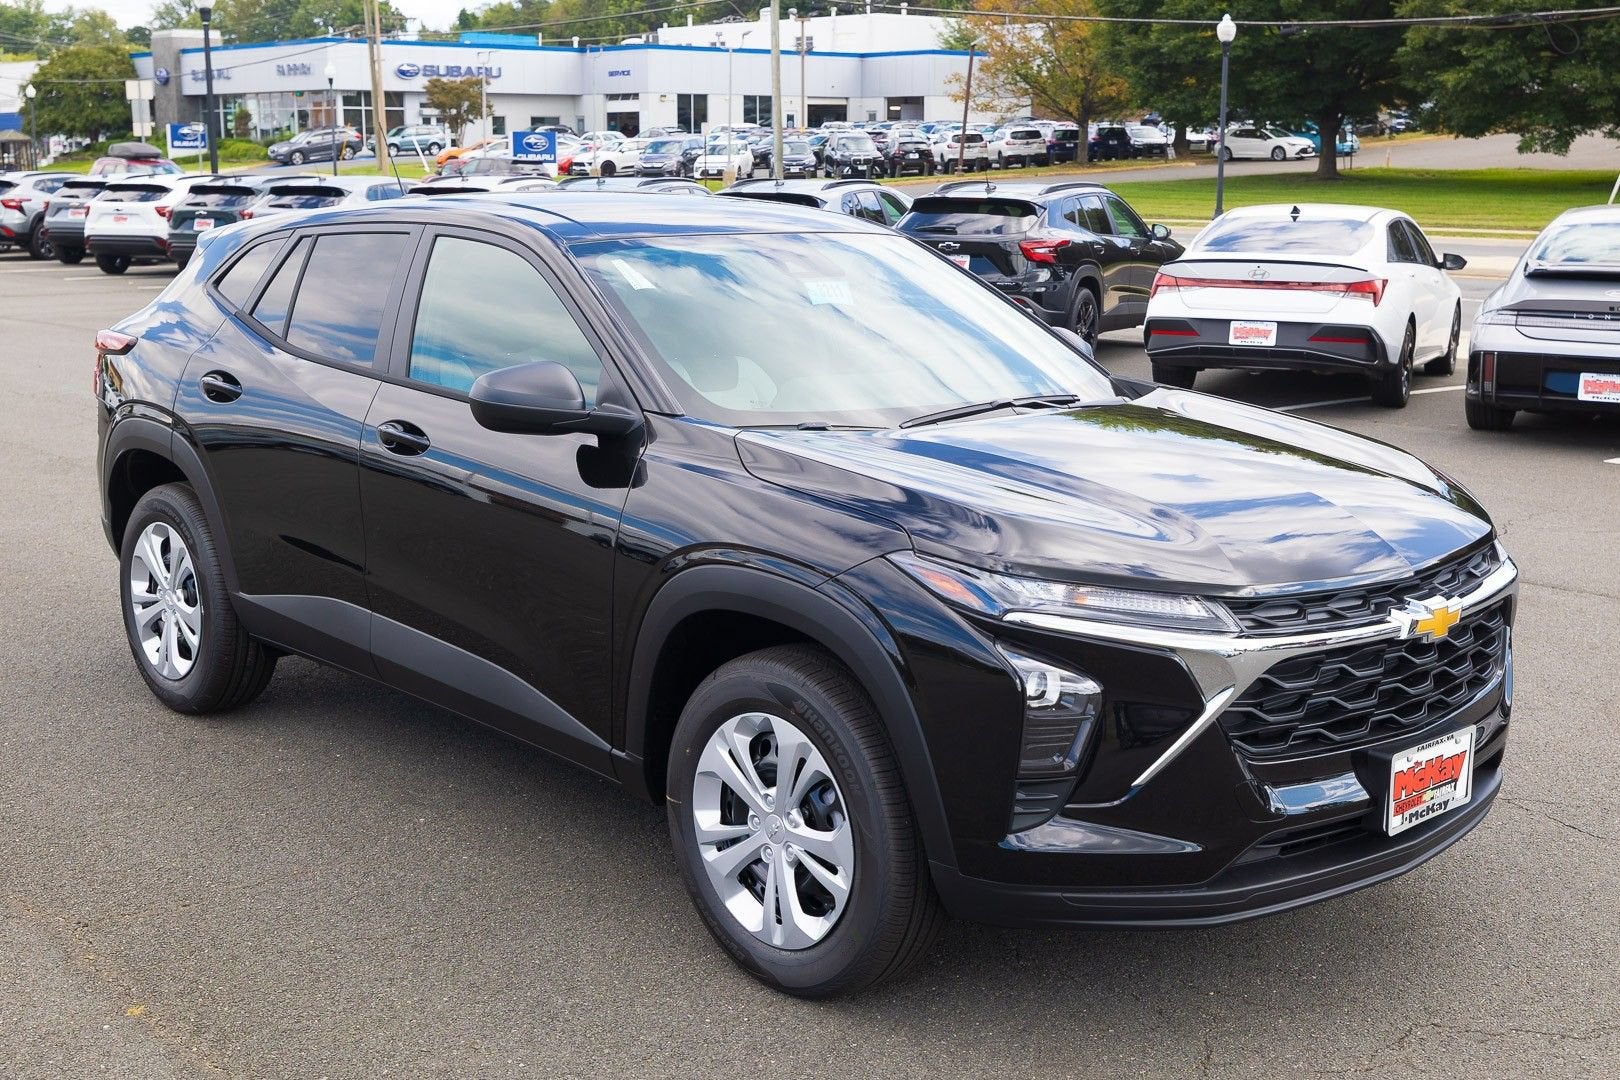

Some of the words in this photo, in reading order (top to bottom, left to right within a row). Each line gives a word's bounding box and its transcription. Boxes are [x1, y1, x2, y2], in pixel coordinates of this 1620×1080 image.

[422, 64, 502, 78] SUBARU
[608, 69, 631, 77] SERVICE
[516, 153, 555, 161] SUBARU
[1393, 749, 1468, 802] McKay
[1408, 798, 1450, 824] McKay
